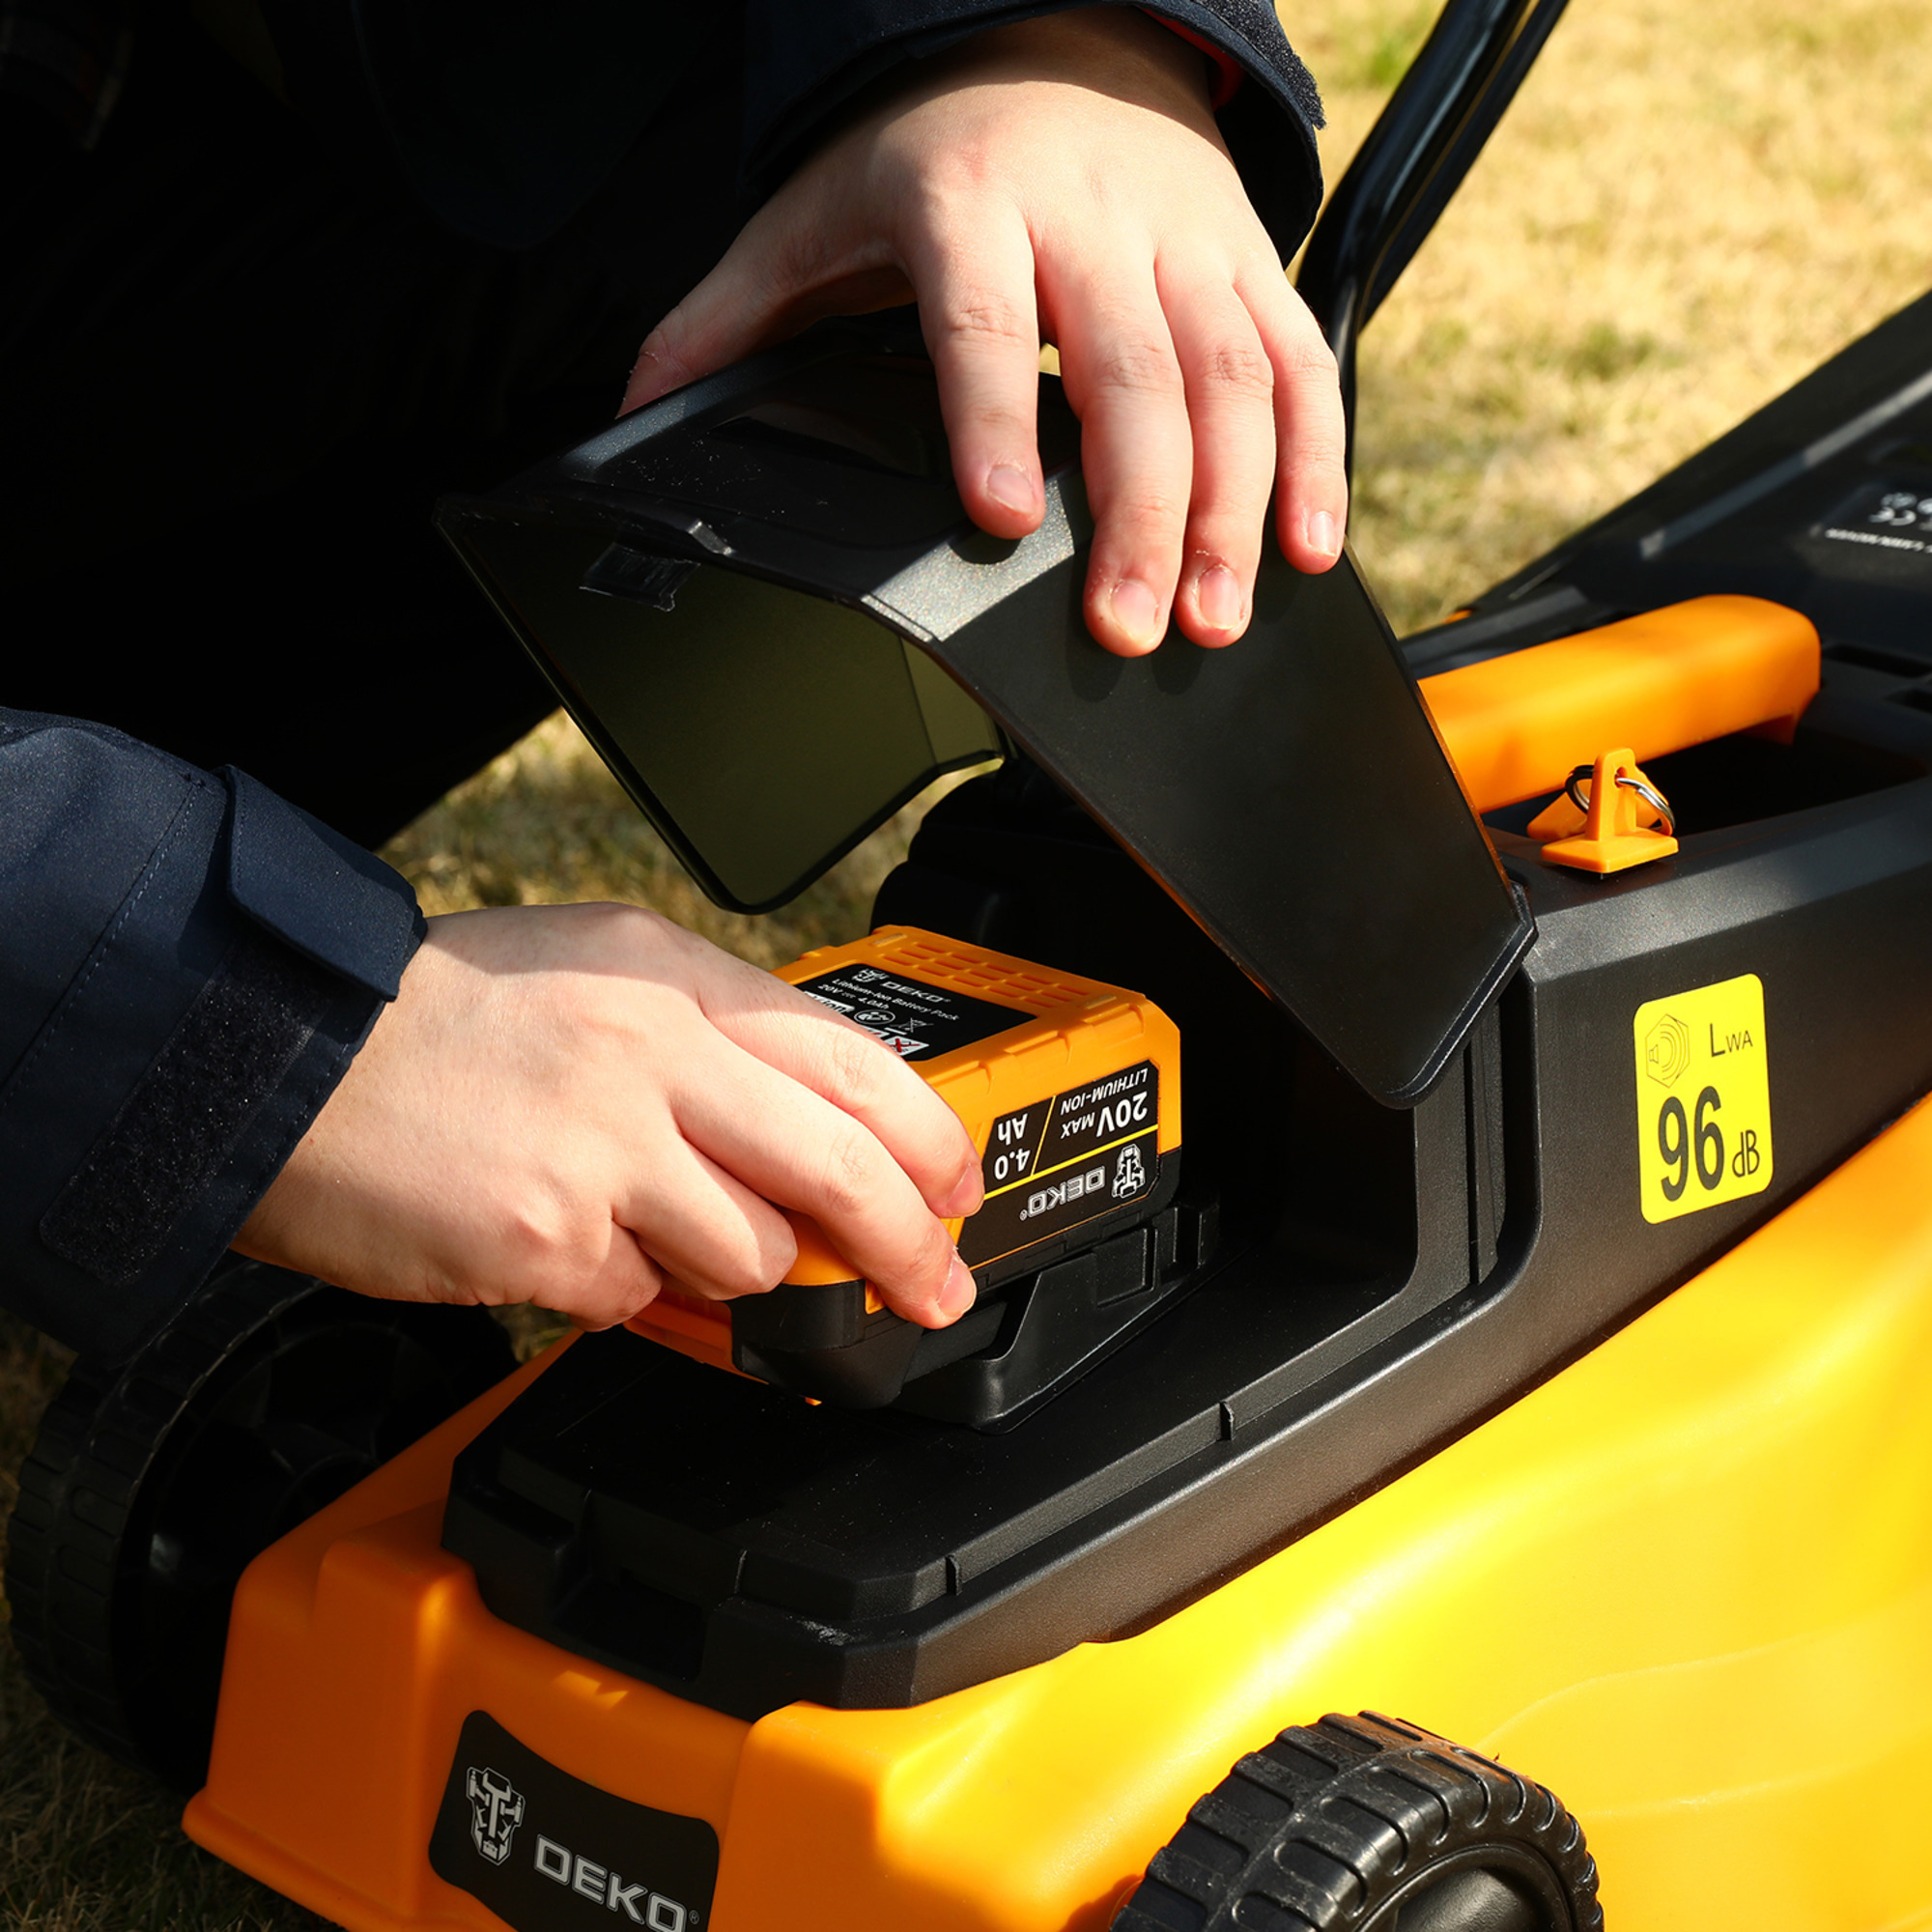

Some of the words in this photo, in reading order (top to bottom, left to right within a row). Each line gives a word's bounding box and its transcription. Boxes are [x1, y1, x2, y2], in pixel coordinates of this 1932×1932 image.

[817, 983, 843, 995] 20V
[858, 996, 890, 1010] 4.0Ah
[892, 997, 932, 1013] Battery
[929, 1009, 960, 1022] Pack
[1060, 1067, 1150, 1116] LITHIUM-ION
[997, 1113, 1029, 1146] Ah
[1060, 1111, 1095, 1140] MAX
[1095, 1091, 1149, 1138] 20V
[1658, 1085, 1724, 1202] 96
[1732, 1129, 1760, 1179] dB
[993, 1147, 1032, 1180] 4.0
